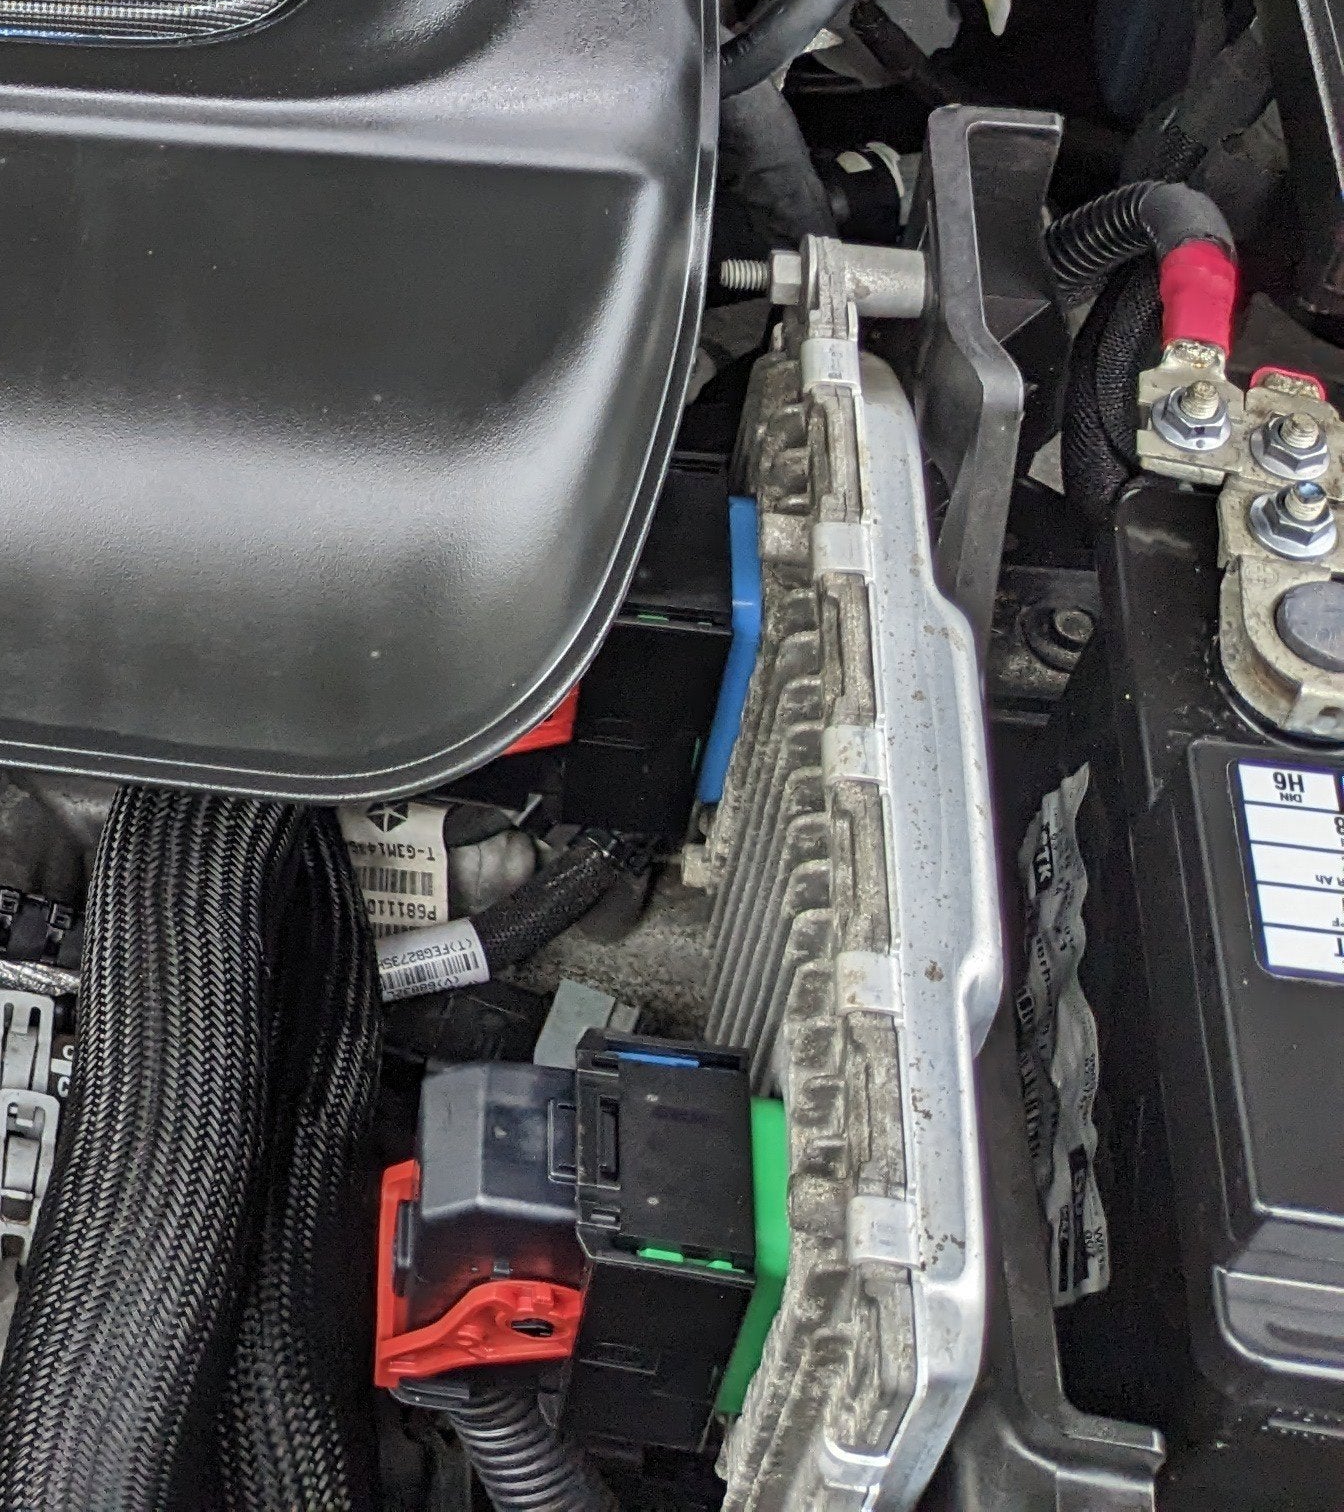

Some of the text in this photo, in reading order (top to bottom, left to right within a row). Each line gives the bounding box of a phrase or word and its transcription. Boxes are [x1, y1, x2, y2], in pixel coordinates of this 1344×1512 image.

[1272, 771, 1305, 793] H6
[1279, 792, 1303, 803] DIN
[1315, 874, 1333, 886] Ah
